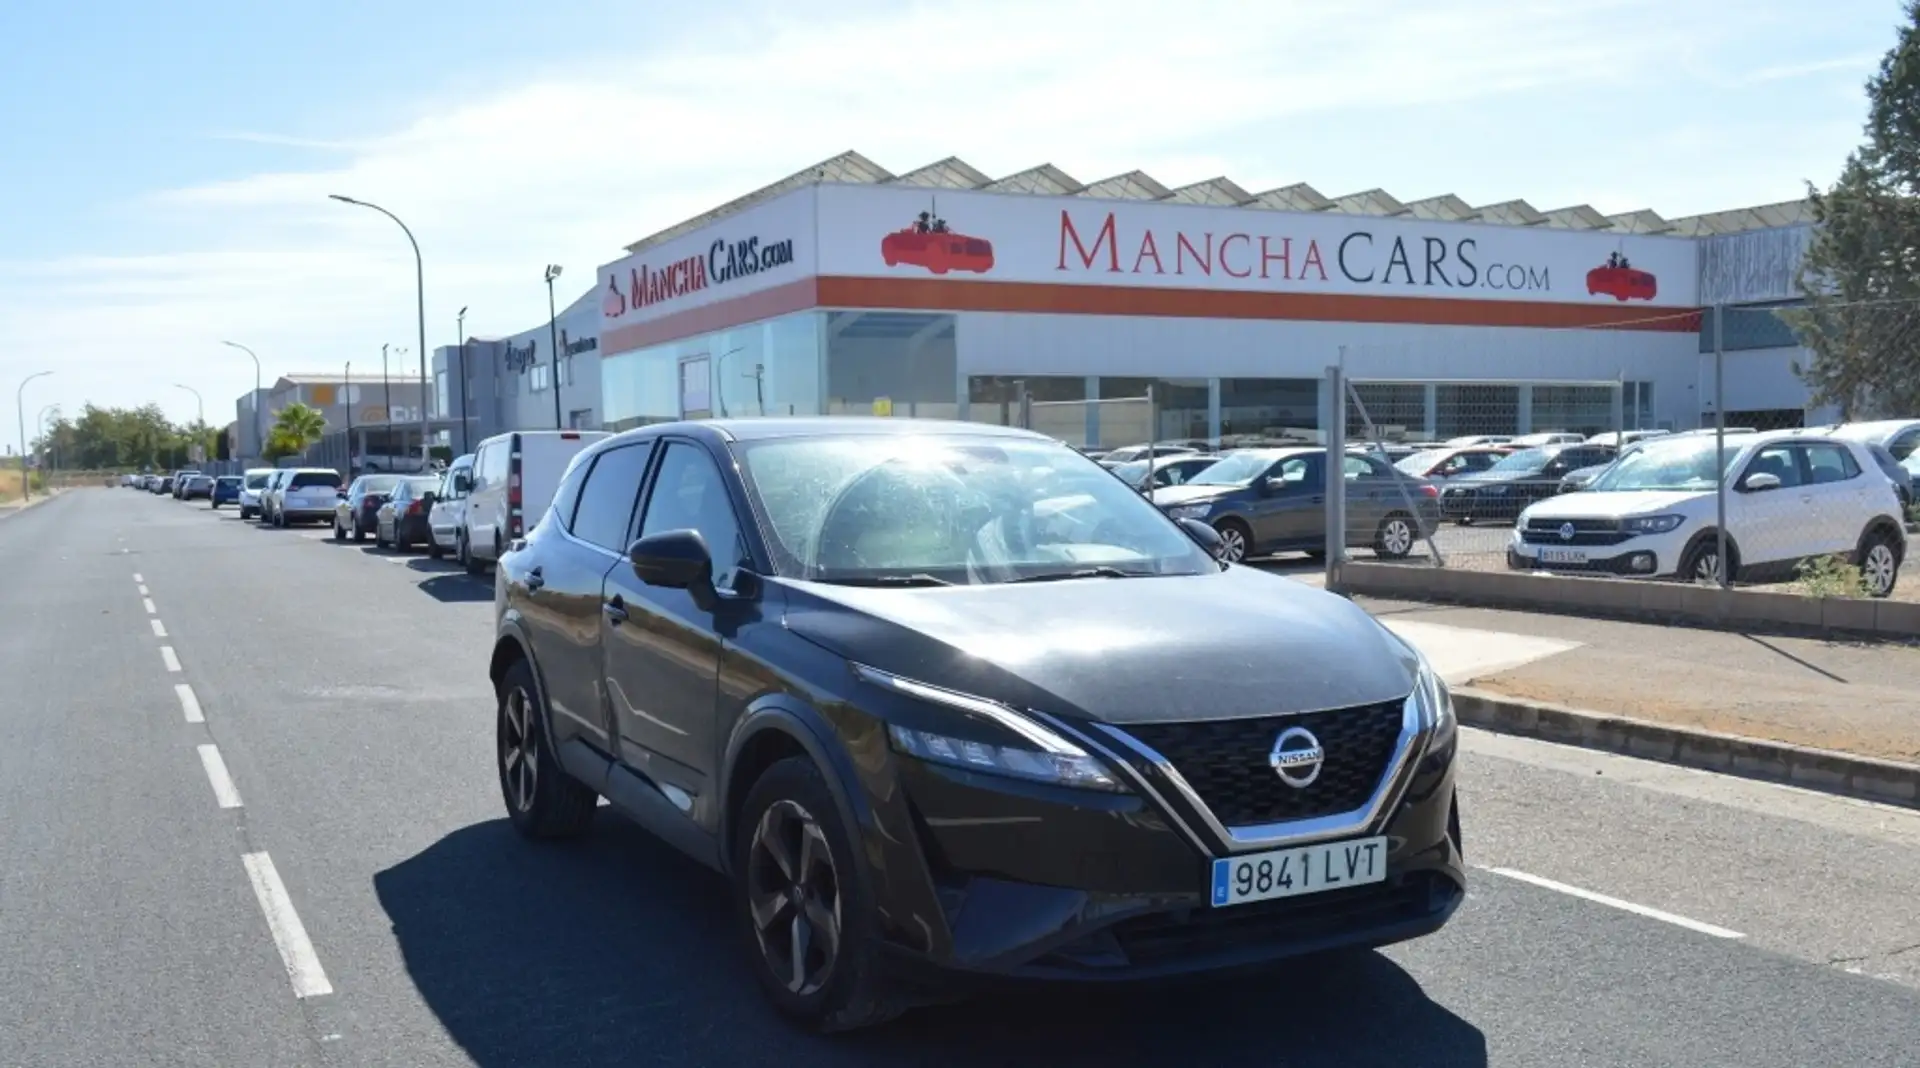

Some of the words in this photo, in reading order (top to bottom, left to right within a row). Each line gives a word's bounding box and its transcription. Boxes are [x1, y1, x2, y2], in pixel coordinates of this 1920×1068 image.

[1278, 751, 1320, 764] NISSAN
[1235, 852, 1310, 897] 9841
[1325, 843, 1379, 883] LVT
